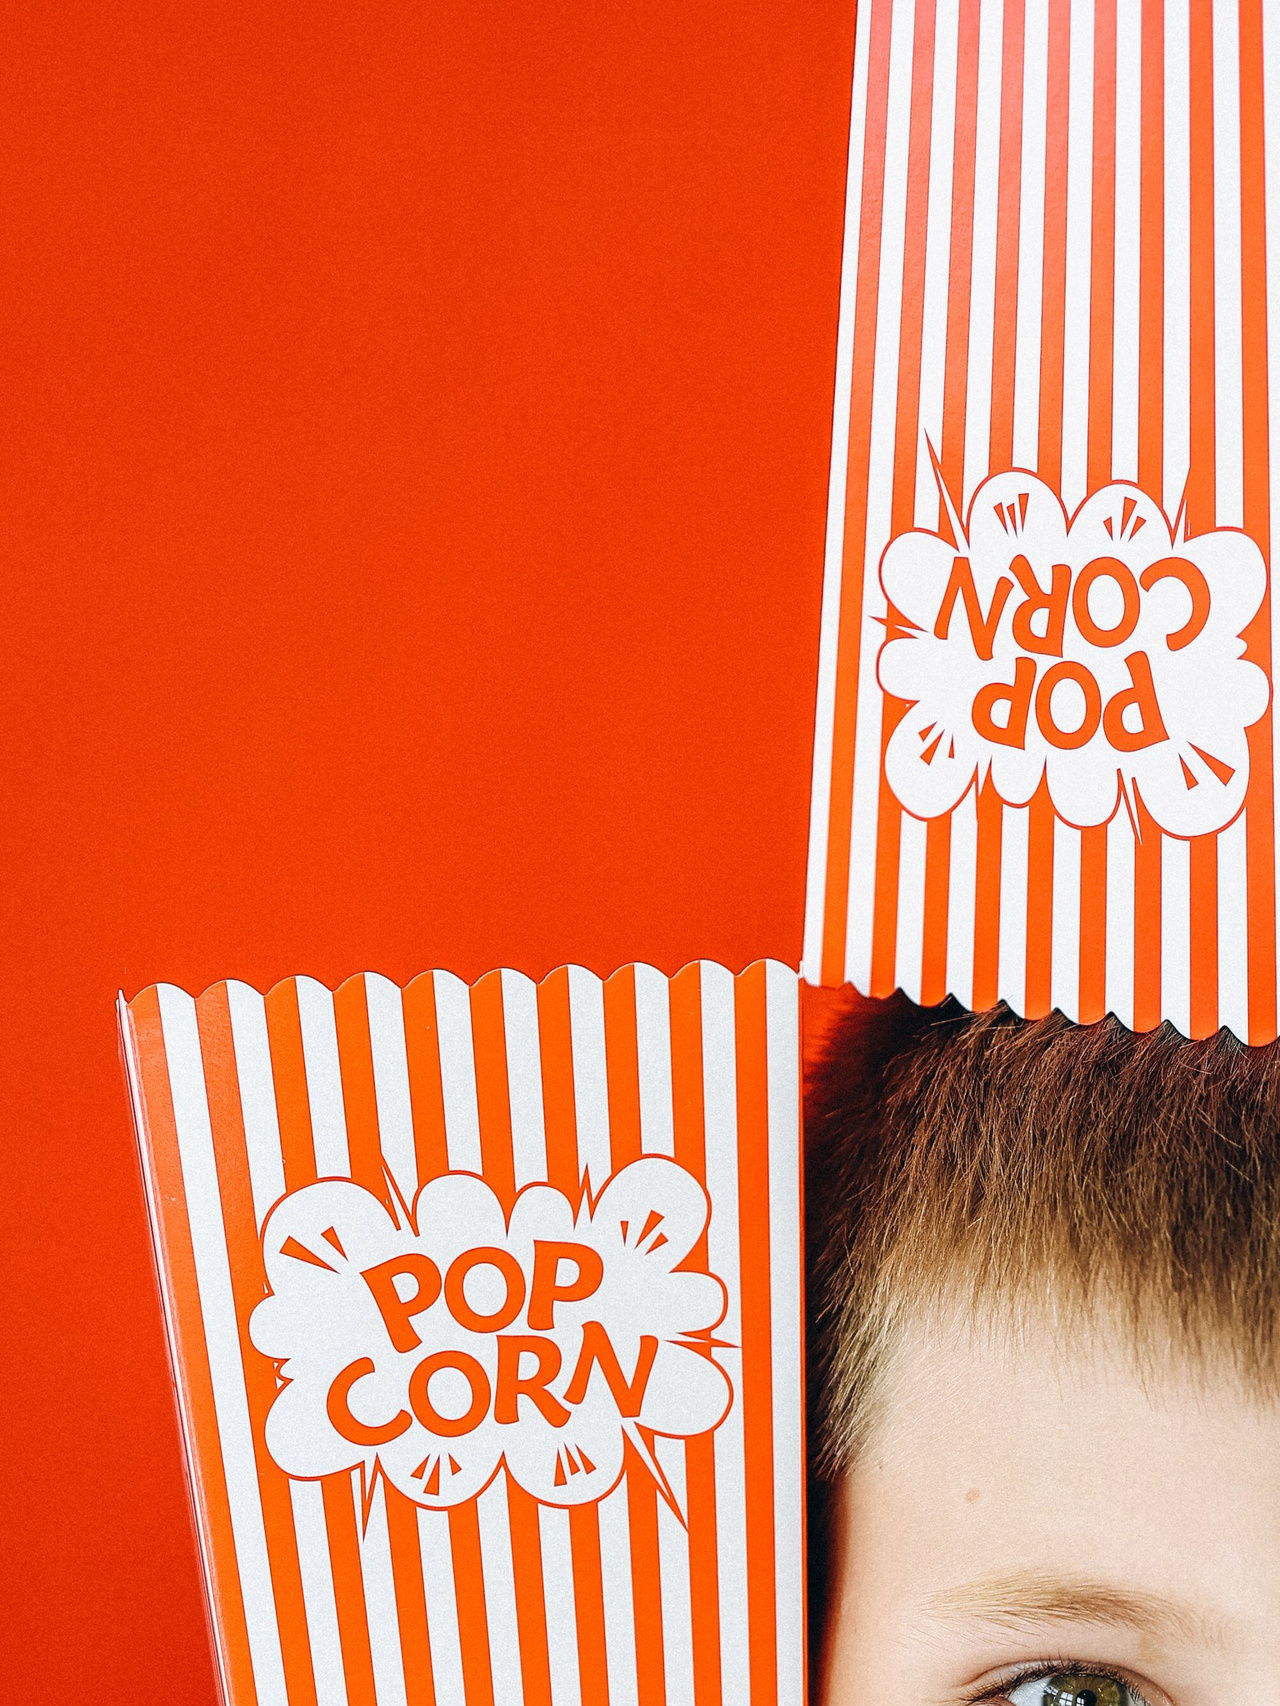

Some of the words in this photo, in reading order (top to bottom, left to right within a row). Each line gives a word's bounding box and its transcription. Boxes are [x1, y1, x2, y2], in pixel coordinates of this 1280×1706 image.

[933, 554, 1211, 661] CORN
[972, 650, 1170, 753] POP
[360, 1239, 604, 1353] POP
[326, 1321, 659, 1446] CORN
